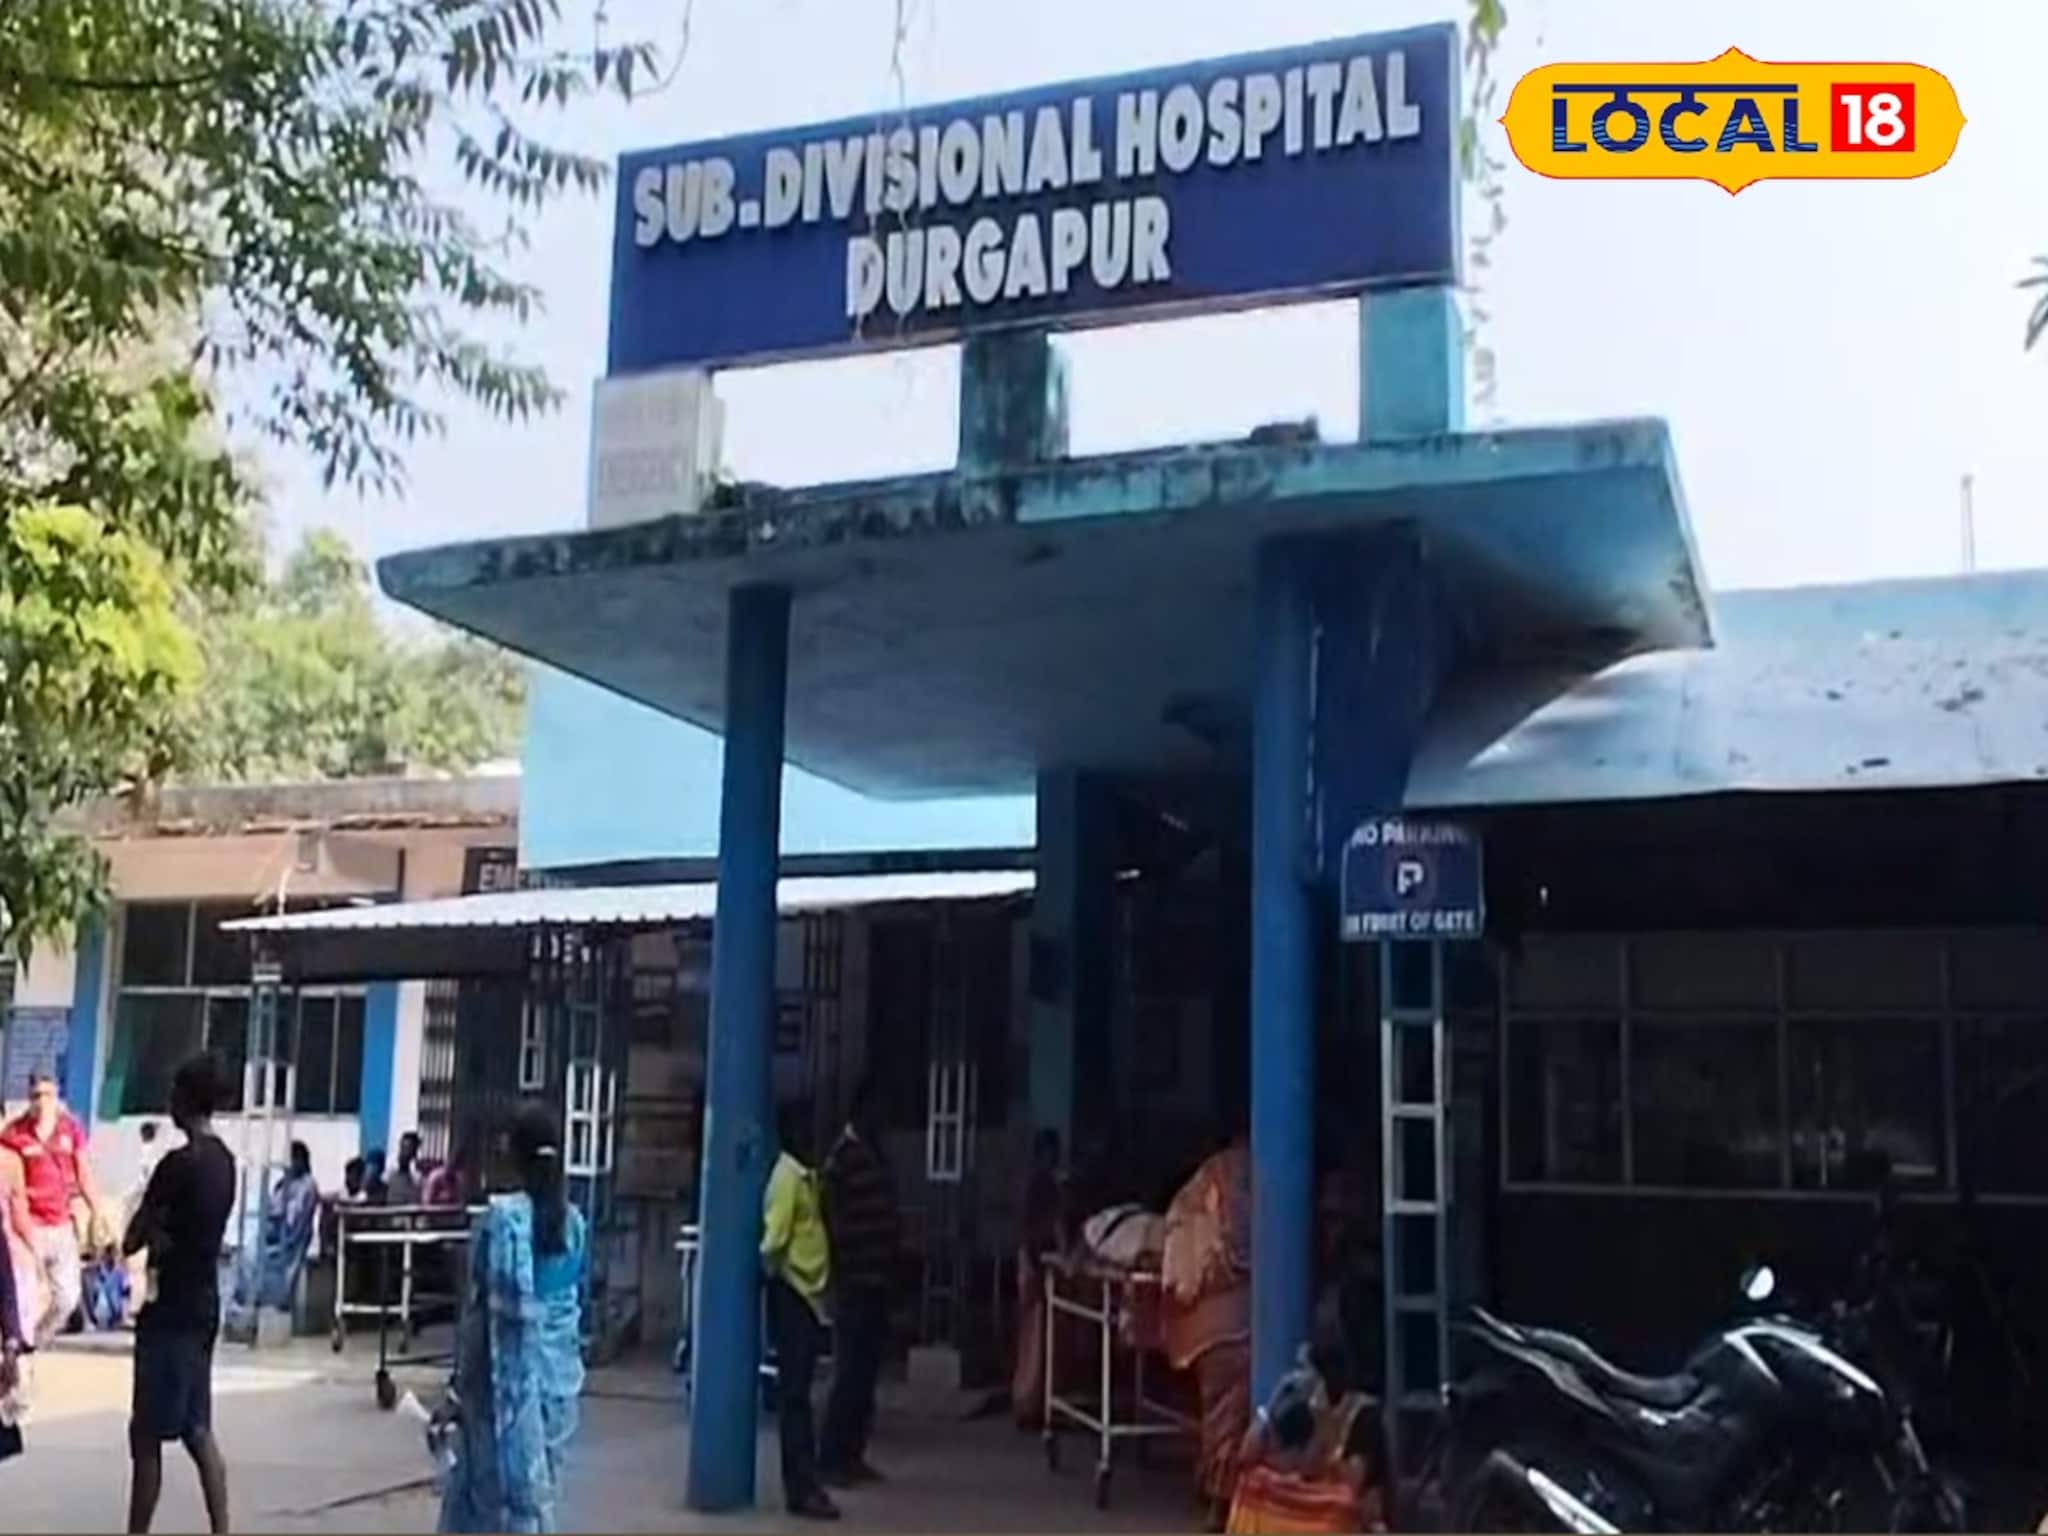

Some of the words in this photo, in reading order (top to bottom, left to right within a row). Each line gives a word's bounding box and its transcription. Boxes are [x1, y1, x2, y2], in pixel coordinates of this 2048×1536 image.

[1116, 51, 1420, 178] HOSPITAL
[847, 196, 1171, 317] DURGAPUR
[1397, 861, 1424, 895] P
